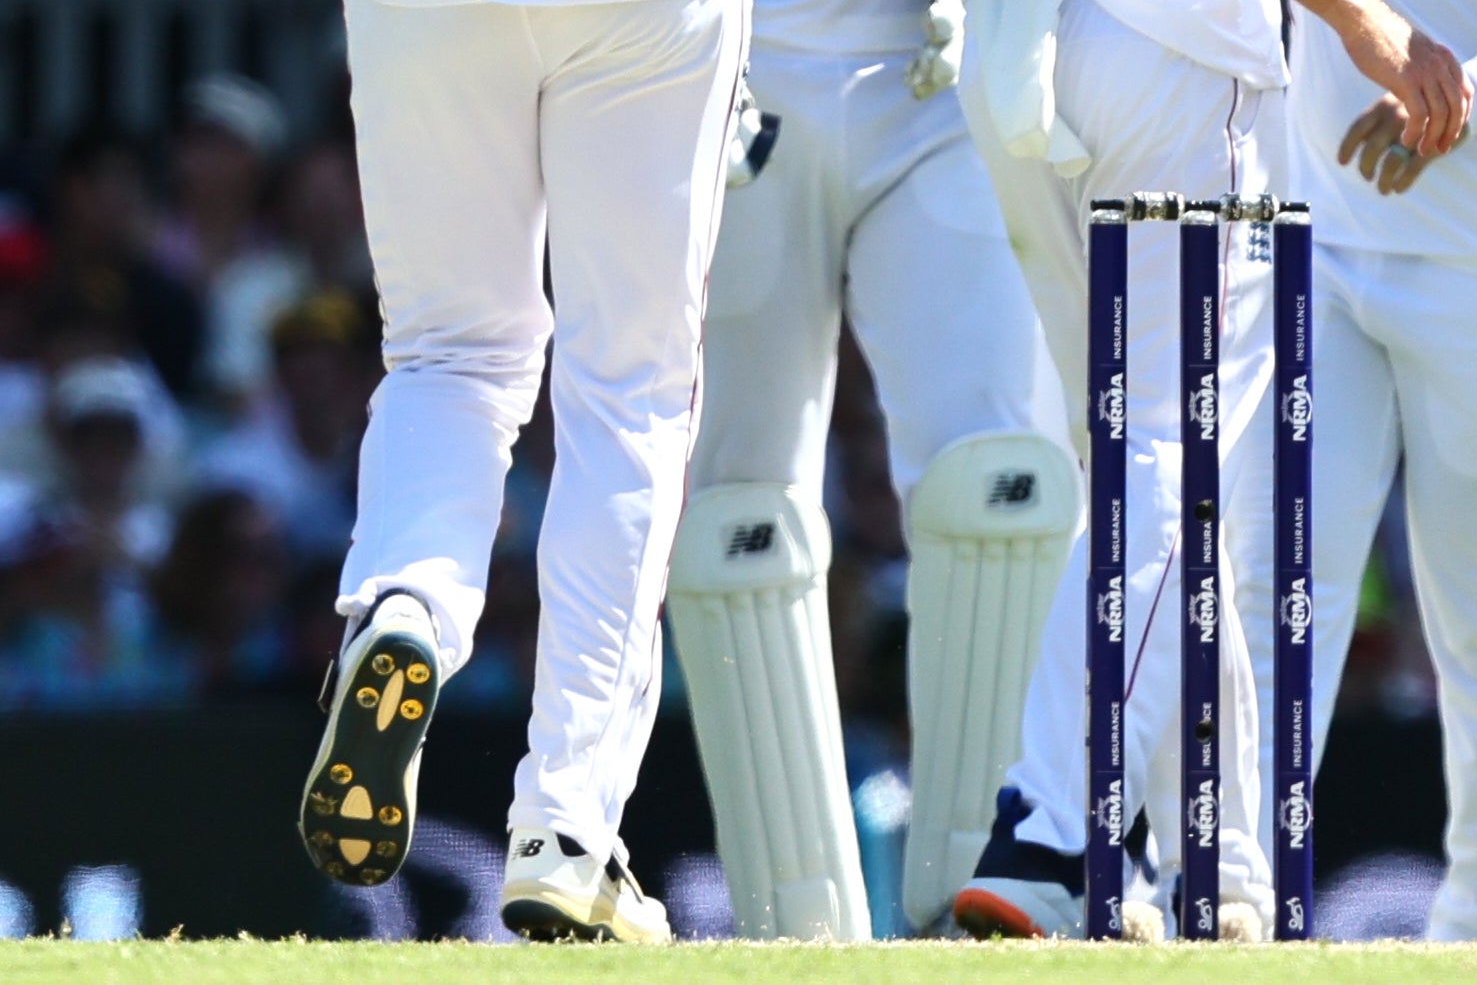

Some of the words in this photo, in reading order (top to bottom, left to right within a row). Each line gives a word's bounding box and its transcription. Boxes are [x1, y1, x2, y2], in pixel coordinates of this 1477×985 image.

[1113, 295, 1123, 359] INSURANCE
[1204, 295, 1212, 360] INSURANCE
[1297, 294, 1306, 361] INSURANCE
[1110, 373, 1124, 440] NRMA
[1201, 373, 1214, 440] NRMA
[1293, 374, 1307, 442] NRMA
[1112, 498, 1121, 562] INSURANCE
[1204, 499, 1212, 563] INSURA
[1295, 497, 1304, 564] INSURANCE
[1109, 575, 1122, 642] NRMA
[1201, 576, 1214, 642] NRMA
[1292, 577, 1305, 644] NRMA
[1112, 701, 1120, 766] INSURANCE
[1293, 699, 1302, 767] INSURANCE
[1109, 779, 1122, 846] NRMA
[1199, 779, 1213, 847] NRMA
[1290, 780, 1304, 848] NRMA
